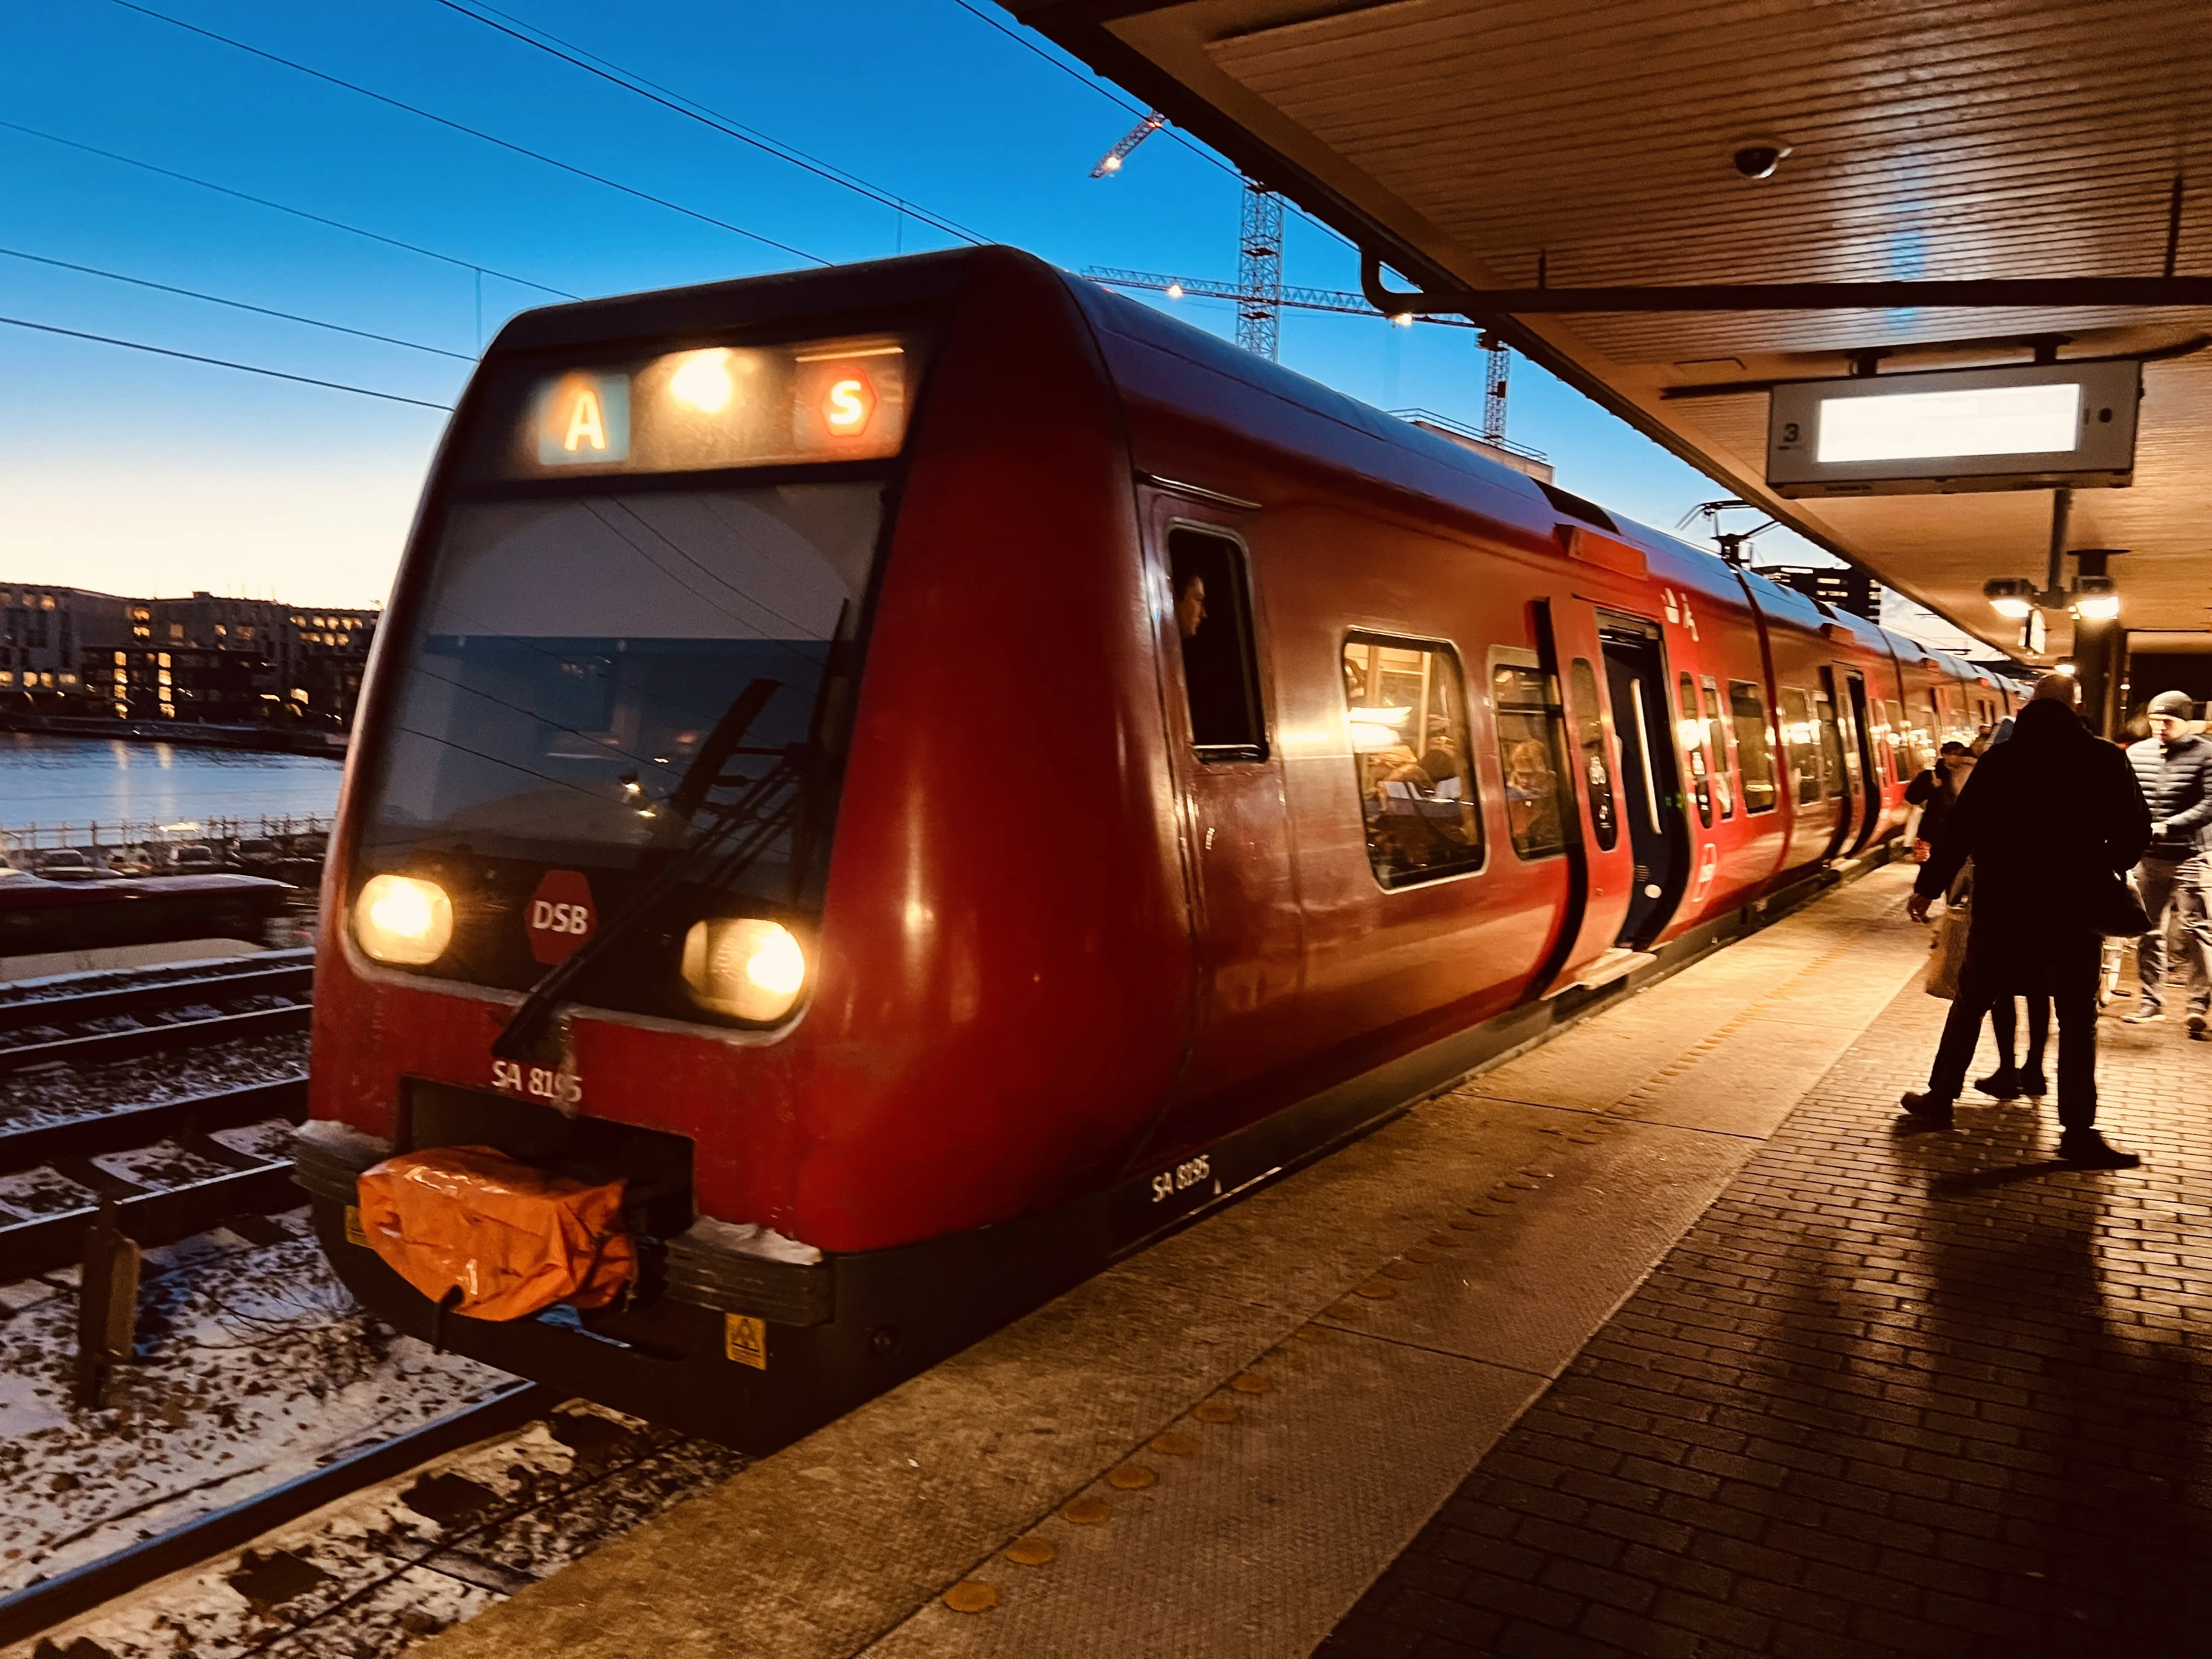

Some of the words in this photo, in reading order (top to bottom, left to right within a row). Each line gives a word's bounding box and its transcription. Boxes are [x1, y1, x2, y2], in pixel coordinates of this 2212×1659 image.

[829, 380, 862, 426] S
[564, 388, 606, 452] A
[1784, 423, 1799, 442] 3
[532, 900, 589, 935] DSB
[491, 1060, 522, 1091] SA
[1151, 1172, 1174, 1203] SA
